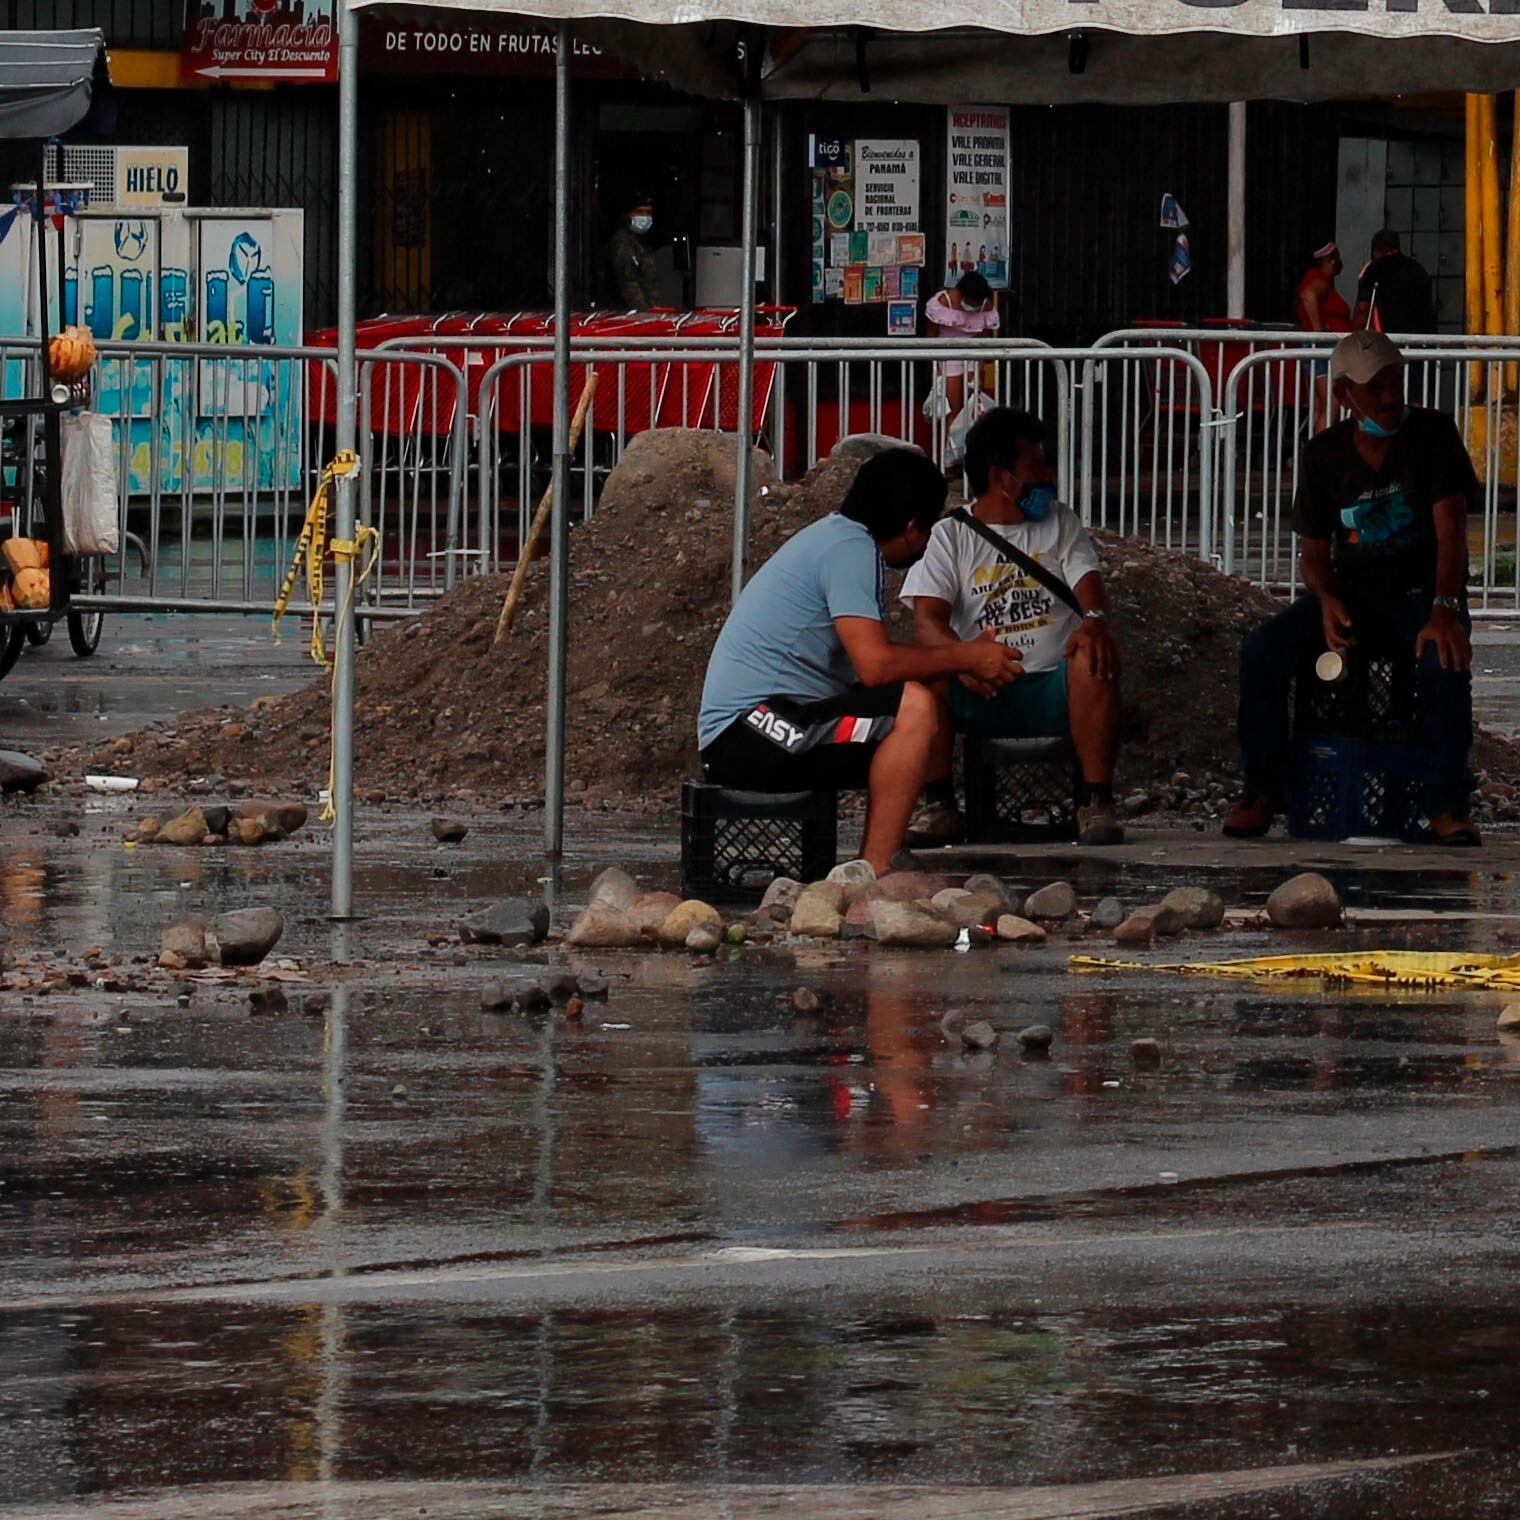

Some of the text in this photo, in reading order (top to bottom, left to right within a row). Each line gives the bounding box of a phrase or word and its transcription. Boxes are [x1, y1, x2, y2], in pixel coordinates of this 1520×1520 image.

[385, 31, 407, 51] DE
[413, 32, 463, 52] TODO
[469, 33, 491, 52] EN
[211, 48, 331, 65] Super City El Descuento
[951, 135, 971, 149] VALE
[952, 153, 973, 167] VALE
[126, 163, 179, 194] HIELO
[953, 171, 974, 185] VALE
[864, 206, 873, 216] DE
[1010, 597, 1052, 623] BEST
[746, 704, 804, 748] EASY
